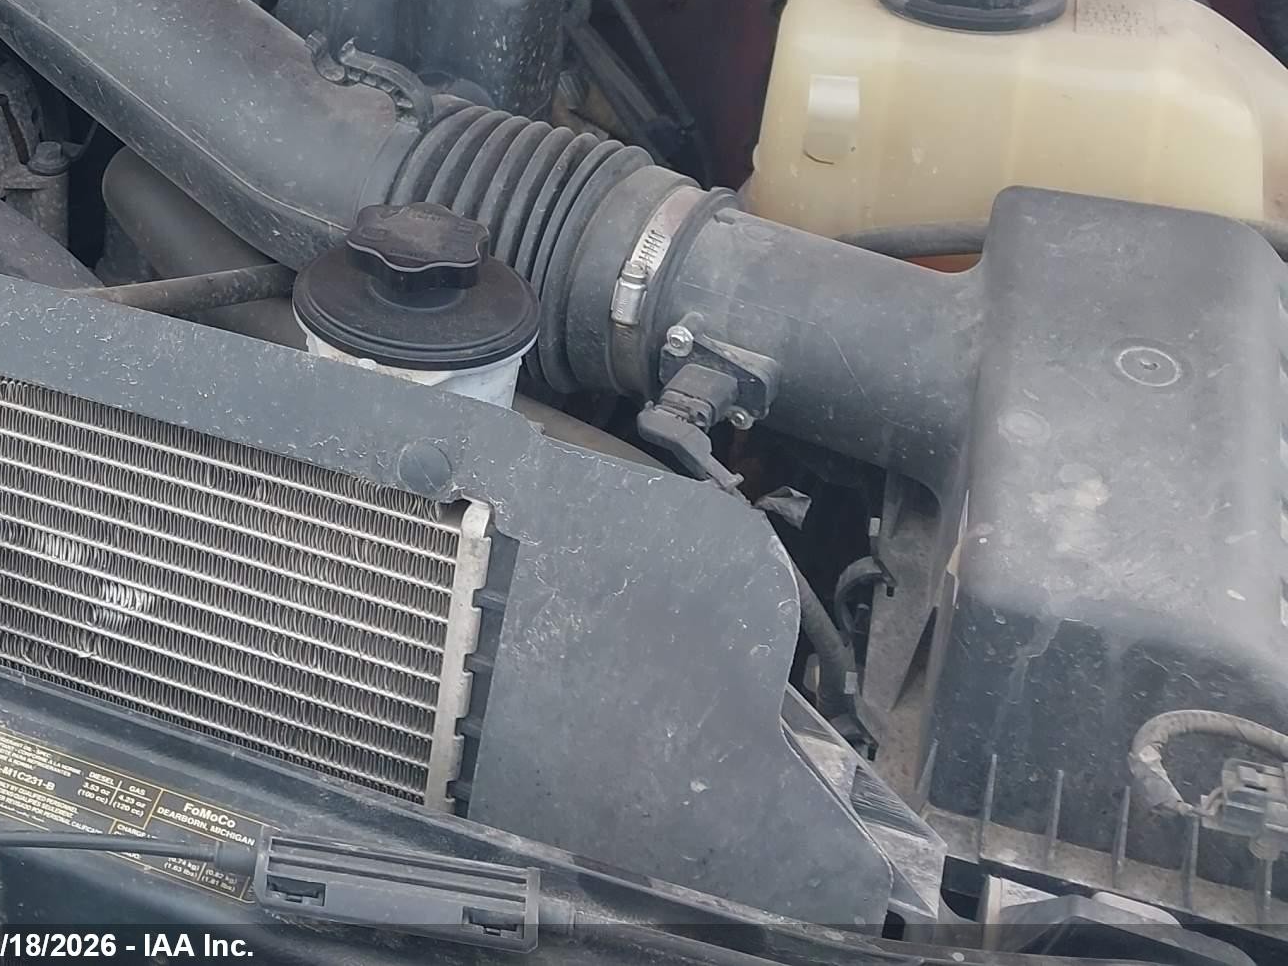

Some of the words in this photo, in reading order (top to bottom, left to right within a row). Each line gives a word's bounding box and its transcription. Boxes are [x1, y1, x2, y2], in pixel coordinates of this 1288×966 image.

[89, 772, 114, 784] DIESEL
[129, 785, 145, 795] GAS
[118, 794, 134, 804] 4.23
[183, 803, 235, 828] FoMoCo
[157, 806, 208, 830] DEARBORN,
[210, 825, 254, 846] MICHIGAN
